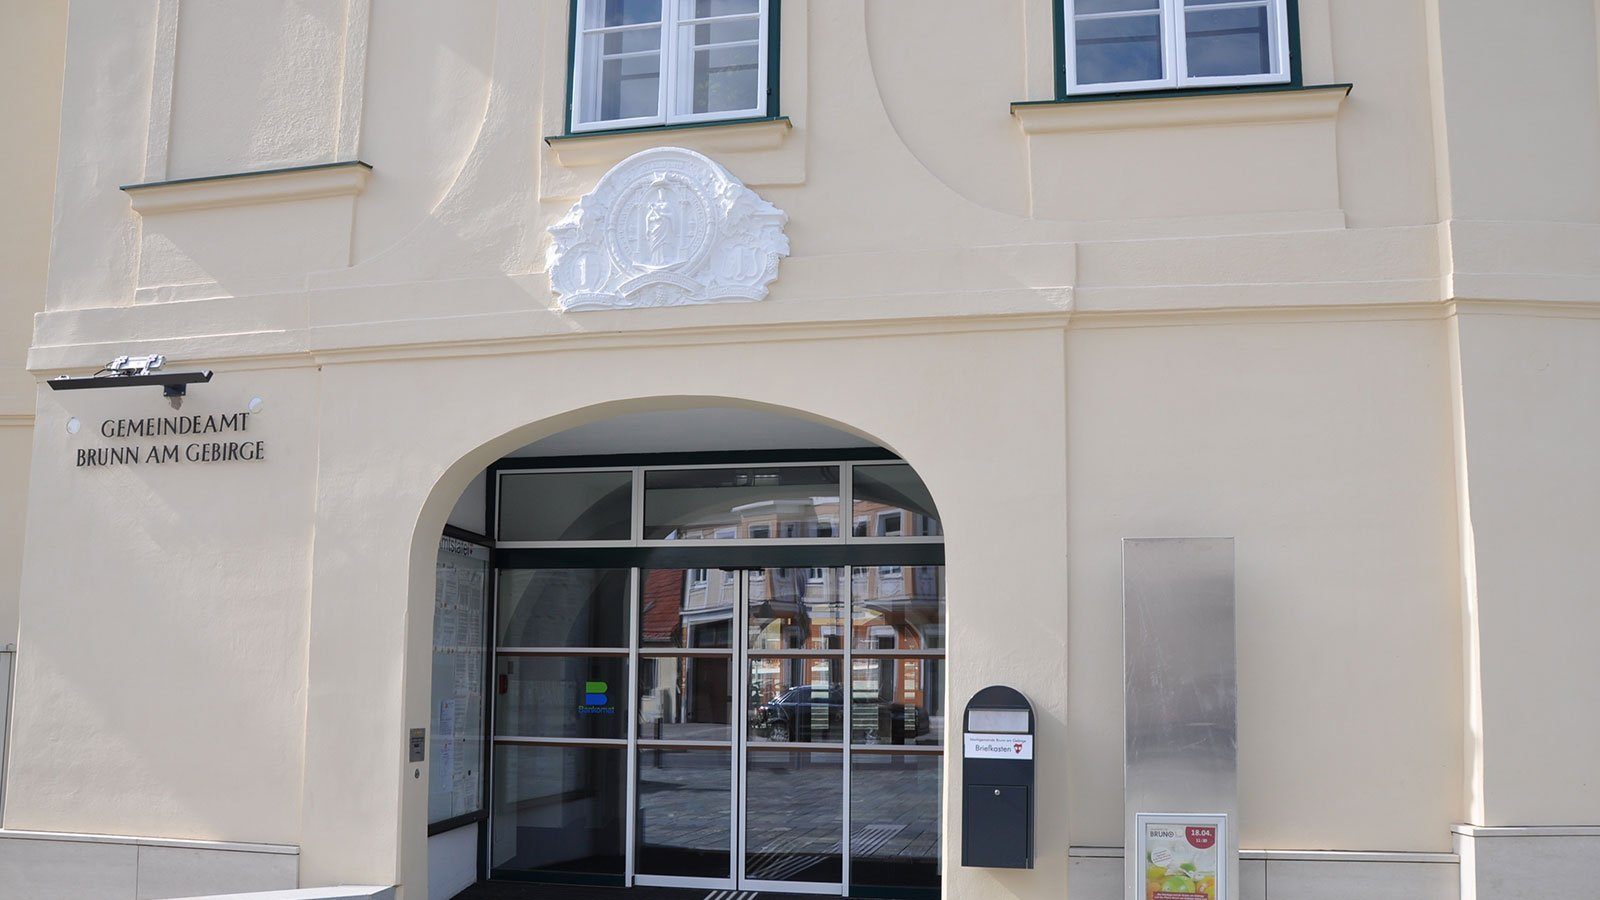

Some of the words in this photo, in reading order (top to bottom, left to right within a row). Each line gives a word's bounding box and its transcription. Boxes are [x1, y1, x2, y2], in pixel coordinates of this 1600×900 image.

[101, 412, 250, 438] GEMEINDEAMT
[76, 447, 139, 467] BRUNN
[145, 444, 179, 464] AM
[185, 440, 265, 463] GEBIRGE
[578, 705, 615, 715] Bankomat
[975, 743, 1012, 753] Briefkasten
[1191, 829, 1213, 837] 18.04.
